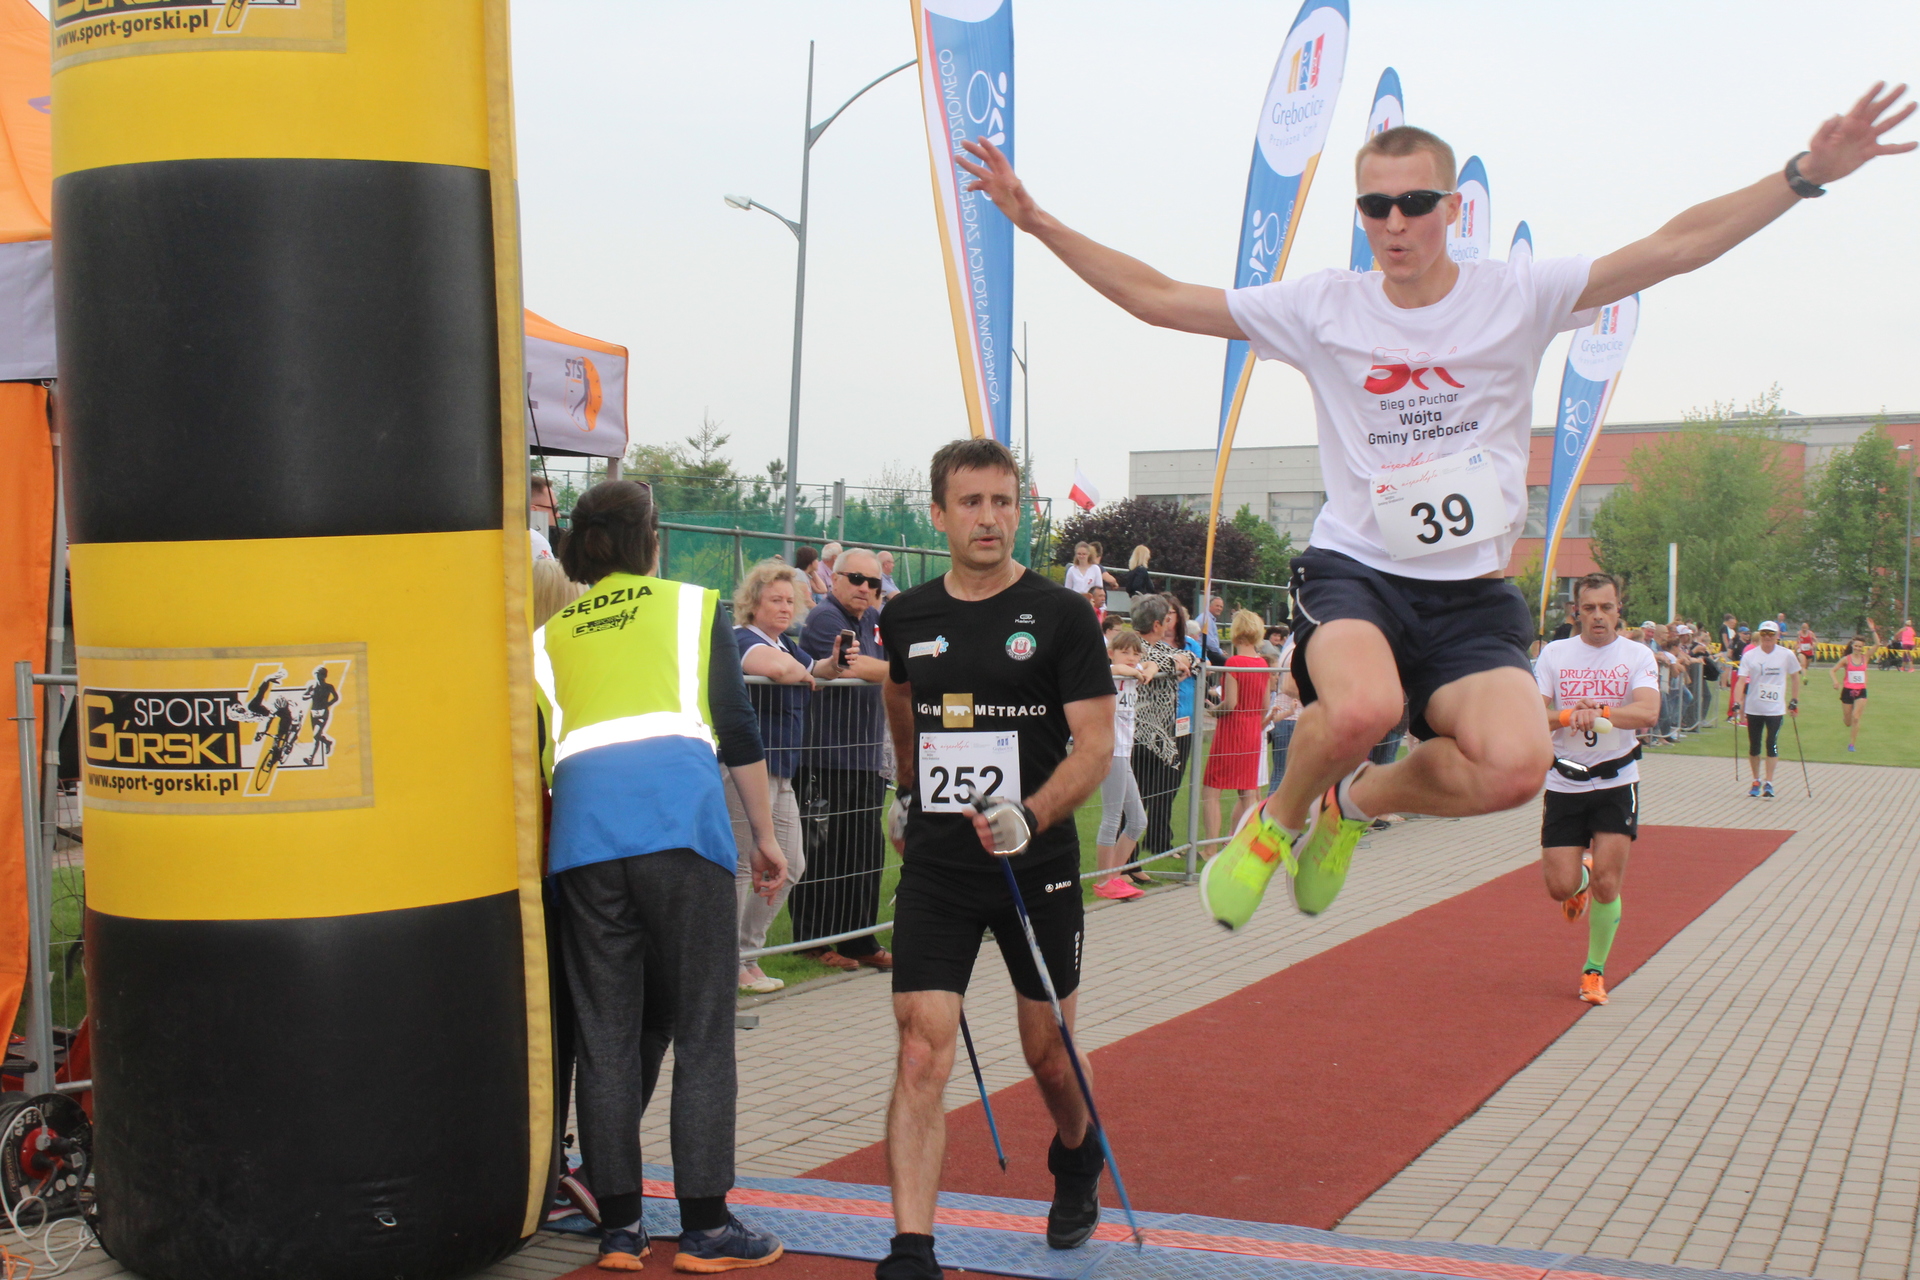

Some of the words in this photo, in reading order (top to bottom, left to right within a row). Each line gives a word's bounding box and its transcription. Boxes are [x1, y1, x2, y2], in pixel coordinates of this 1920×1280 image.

[56, 9, 209, 47] www.sport-gorski.pl
[565, 358, 583, 379] STS
[1380, 399, 1405, 411] Bieg
[1408, 398, 1416, 408] o
[1419, 393, 1459, 406] Puchar
[1399, 410, 1442, 426] Wójta
[1368, 431, 1408, 445] Gminy
[1413, 421, 1479, 441] Grębocice
[1410, 493, 1475, 545] 39
[562, 586, 653, 619] SĘDZIA
[1559, 667, 1617, 680] DRUŻYNA
[1560, 680, 1630, 698] SZPIKU
[1760, 689, 1779, 701] 240
[134, 698, 230, 727] SPORT
[974, 704, 1047, 717] METRACO
[84, 694, 236, 765] GÓRSKI
[1584, 729, 1598, 748] 9
[88, 773, 239, 796] www.sport-gorski.pl
[929, 765, 1004, 805] 252
[1054, 880, 1072, 890] JAKO
